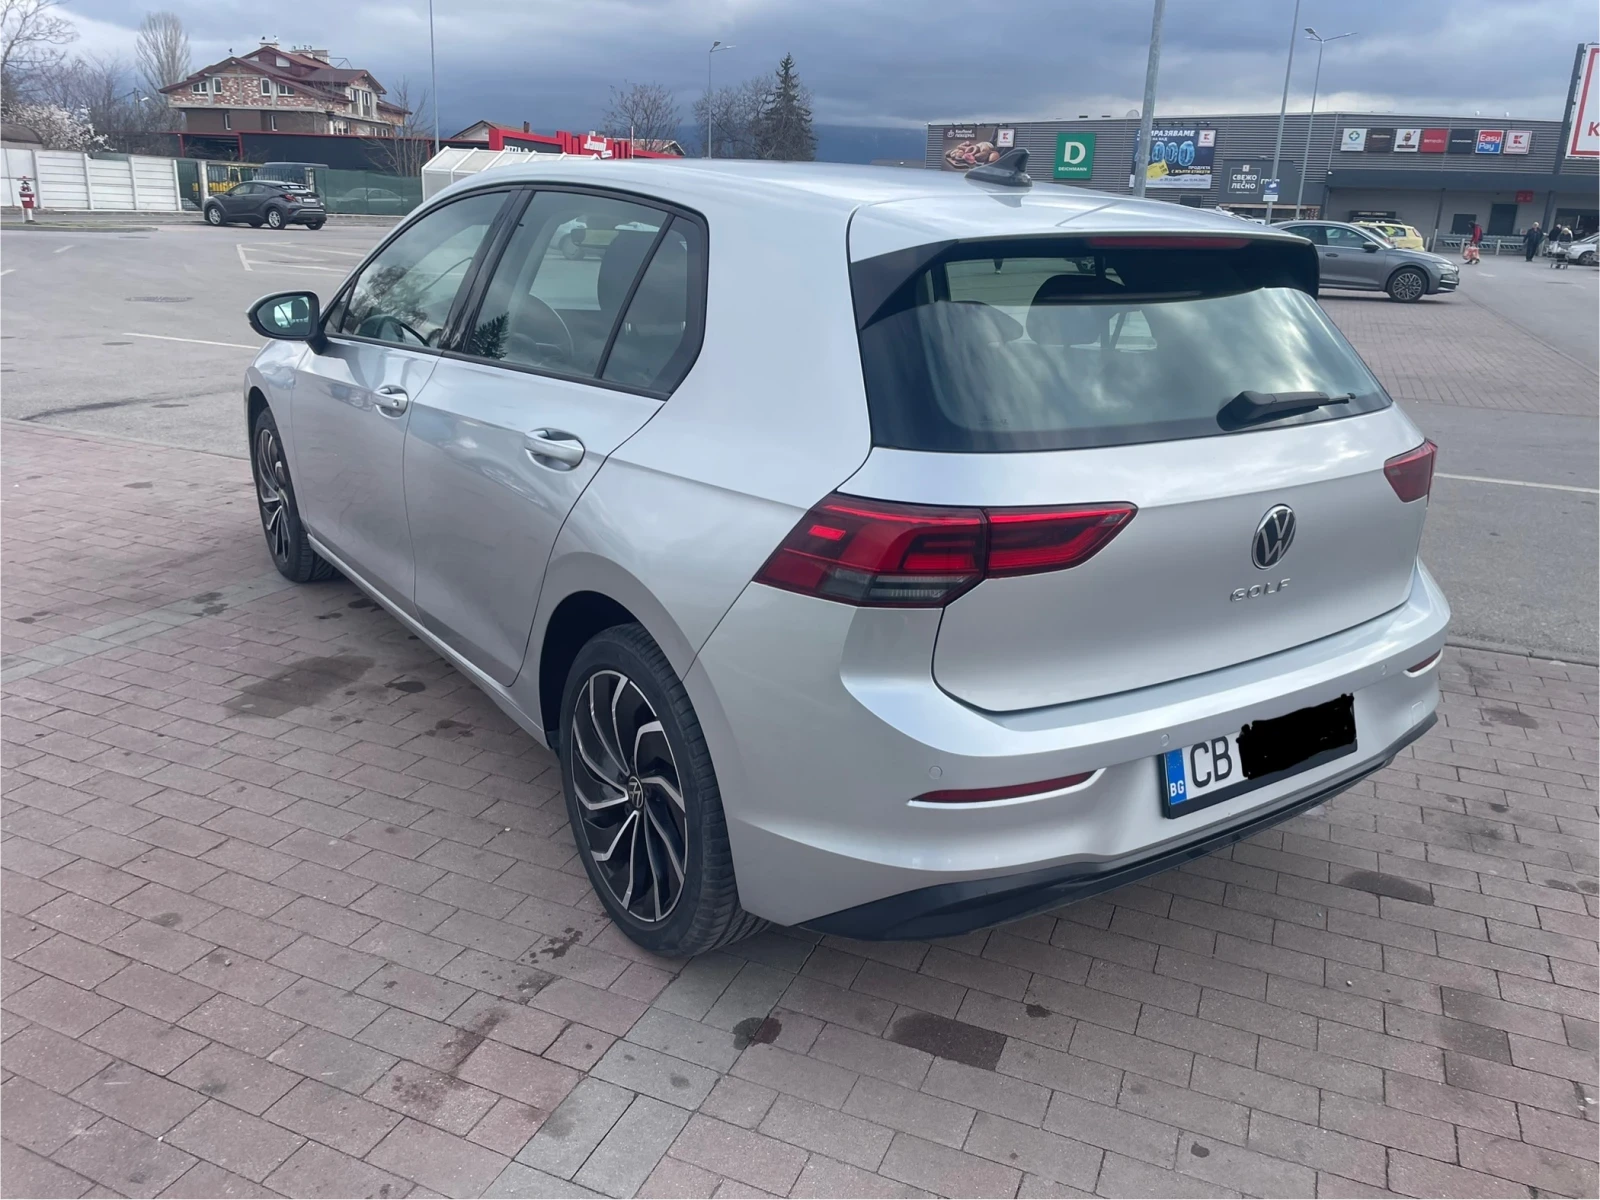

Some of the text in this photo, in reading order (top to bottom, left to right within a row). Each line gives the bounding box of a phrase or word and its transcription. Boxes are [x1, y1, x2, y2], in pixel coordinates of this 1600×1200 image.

[1479, 142, 1495, 151] Pay
[1480, 134, 1501, 143] Easy
[1064, 141, 1086, 164] D
[1134, 140, 1195, 166] 000
[1230, 578, 1290, 602] GOLF
[1190, 736, 1232, 788] CB
[1170, 780, 1184, 797] BG
